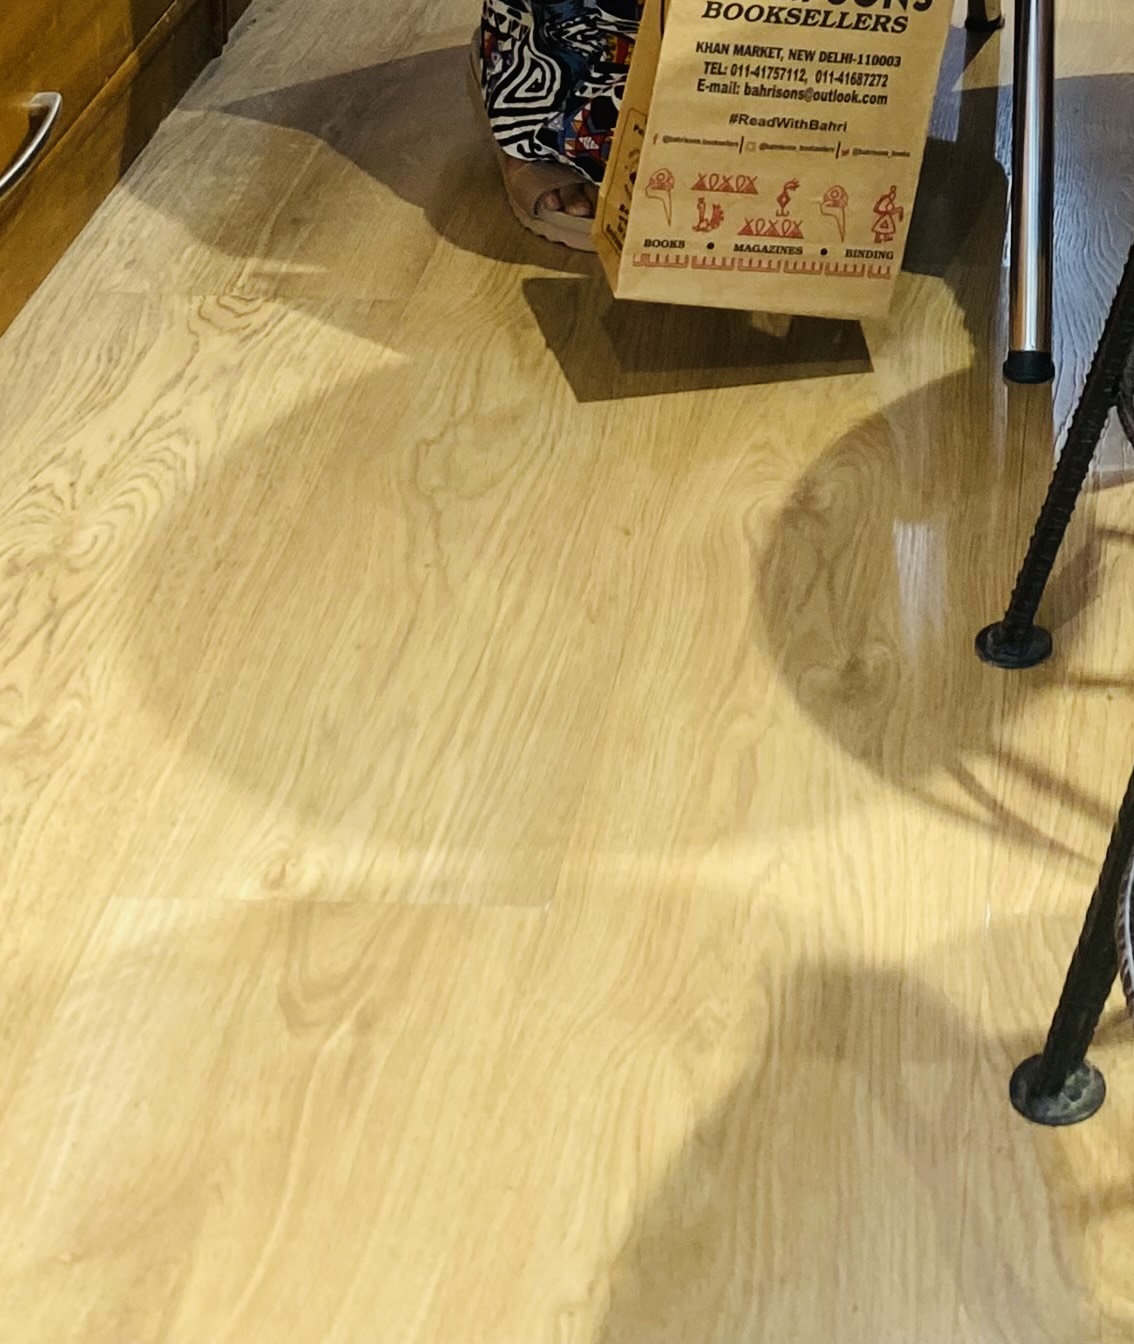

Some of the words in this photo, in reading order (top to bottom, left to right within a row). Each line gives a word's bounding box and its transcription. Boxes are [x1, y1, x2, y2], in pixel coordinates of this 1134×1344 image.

[701, 1, 909, 34] BOOKSELLERS
[695, 41, 730, 56] KHAN
[733, 43, 784, 62] MARKET,
[788, 49, 815, 62] NEW
[819, 51, 902, 67] DELHI-110003
[704, 62, 728, 76] TEL:
[730, 63, 808, 83] 011-41757112,
[697, 78, 740, 95] E-mail:
[744, 82, 888, 105] bahrisons@outlook.com
[728, 113, 848, 132] #ReadWithBahri
[643, 238, 685, 249] BOOKS
[734, 244, 804, 255] MAGAZINES
[844, 249, 894, 260] BINDING
